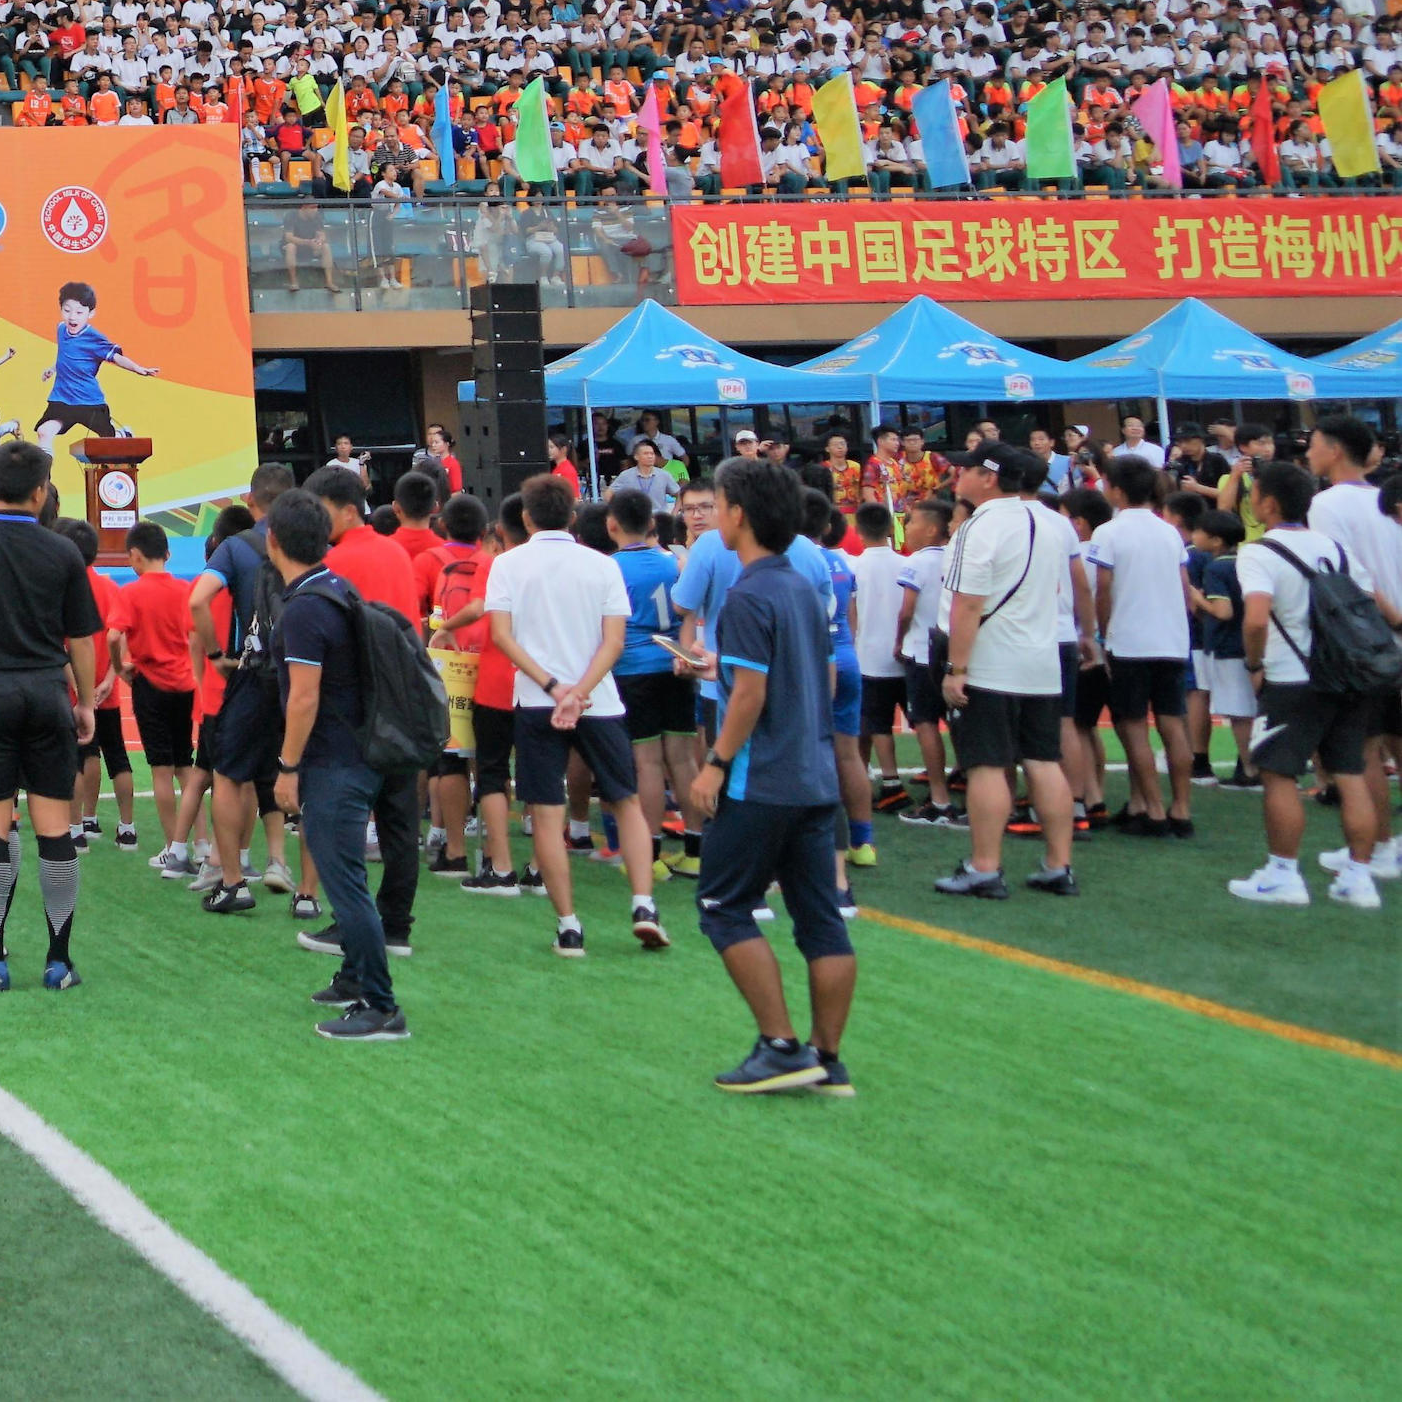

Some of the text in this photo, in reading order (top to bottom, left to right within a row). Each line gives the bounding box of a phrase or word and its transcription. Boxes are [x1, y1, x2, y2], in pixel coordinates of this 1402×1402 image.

[688, 217, 1127, 286] 创建中国足球特区
[650, 582, 672, 631] 1
